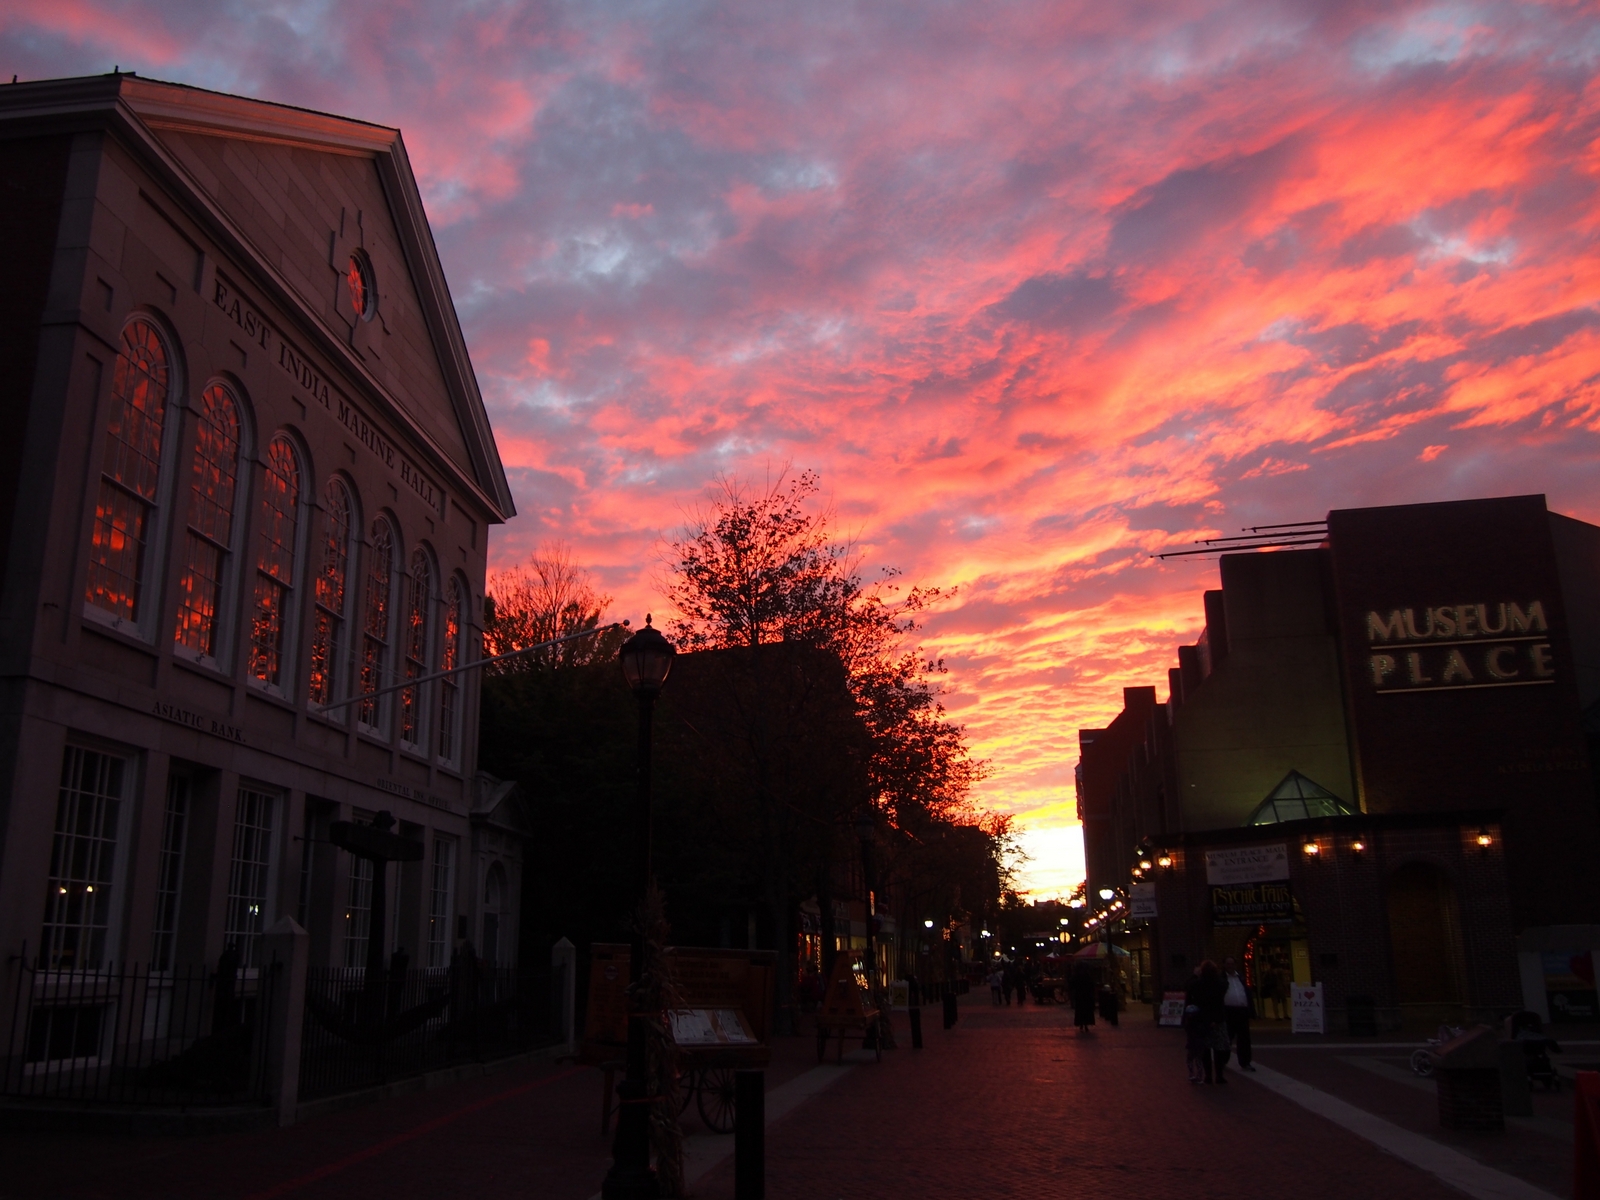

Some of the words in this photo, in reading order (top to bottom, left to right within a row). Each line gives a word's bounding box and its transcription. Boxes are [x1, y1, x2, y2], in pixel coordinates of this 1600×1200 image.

[212, 278, 270, 349] EAST
[278, 342, 330, 410] INDIA
[337, 399, 394, 469] MARINE
[1367, 600, 1548, 641] MUSEUM
[1371, 643, 1555, 685] PLACE
[152, 701, 203, 728] ASIATIC
[1206, 851, 1237, 860] MUSEUM
[1240, 848, 1262, 857] PLACE
[1224, 854, 1269, 867] ENTRANCE
[1212, 887, 1260, 906] PSYCHIC
